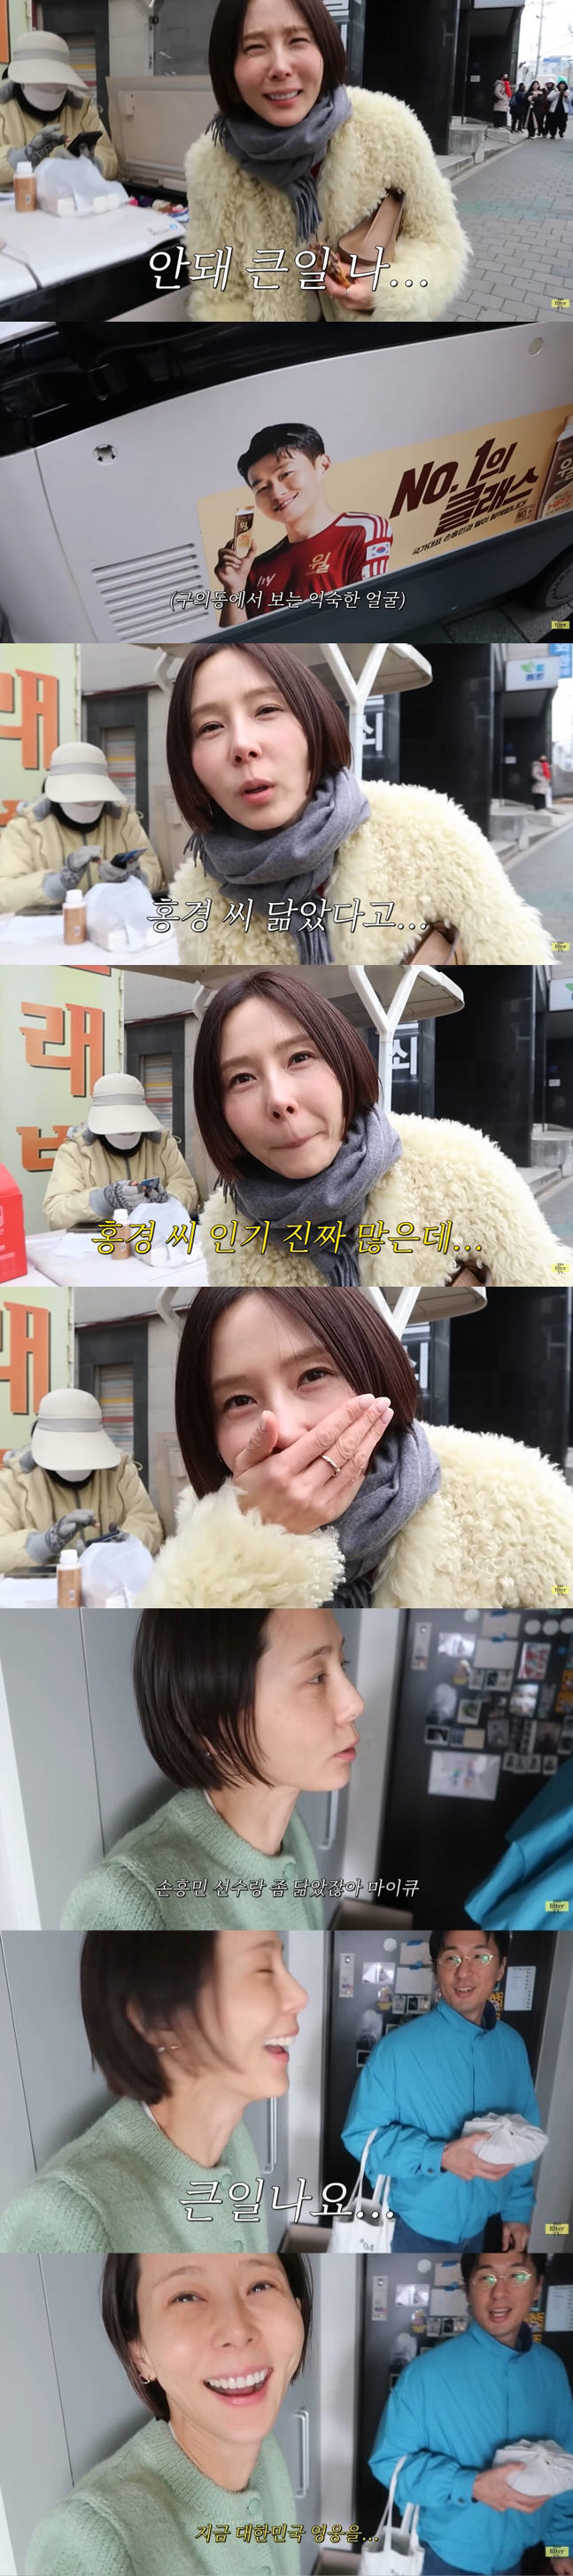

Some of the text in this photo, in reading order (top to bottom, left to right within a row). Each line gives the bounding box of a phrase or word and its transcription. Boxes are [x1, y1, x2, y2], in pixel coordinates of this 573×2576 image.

[434, 466, 539, 537] 클래스
[412, 537, 443, 556] 국가대표
[444, 524, 474, 542] 손흥민과
[19, 1000, 105, 1097] 래
[391, 1037, 418, 1075] 쇠
